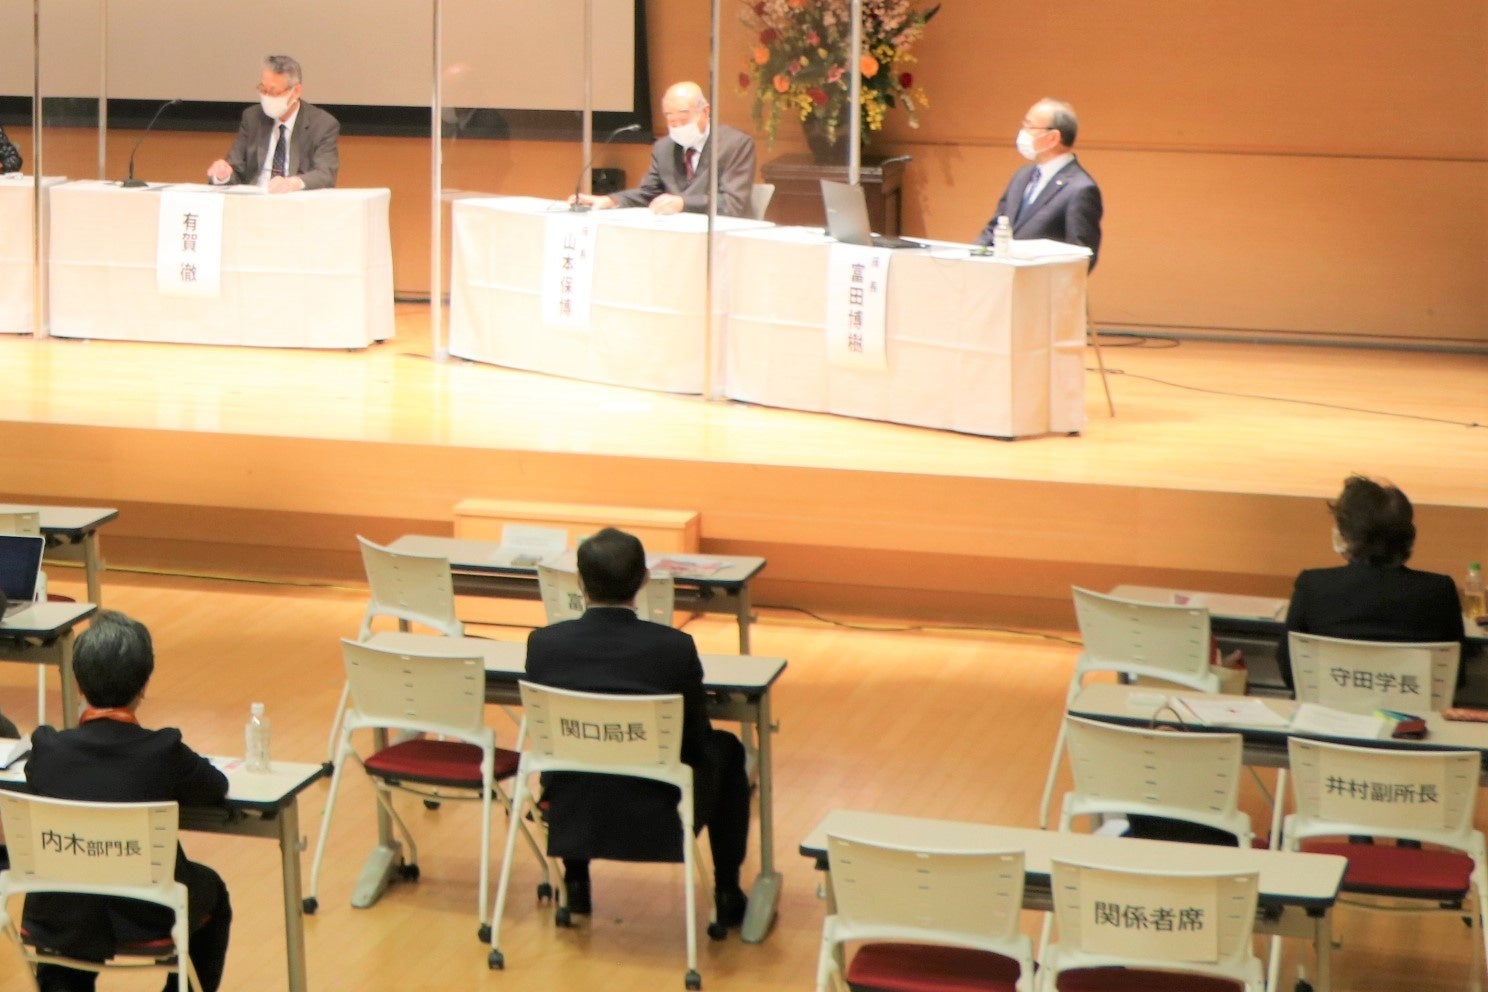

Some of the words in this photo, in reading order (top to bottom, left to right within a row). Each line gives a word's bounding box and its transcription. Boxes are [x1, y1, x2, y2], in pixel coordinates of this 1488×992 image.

[1330, 667, 1420, 695] 守田学長
[560, 717, 647, 743] 関口局長
[1326, 775, 1439, 804] 井村副所長
[41, 830, 142, 857] 内木部門長
[1095, 901, 1204, 932] 関係者席
